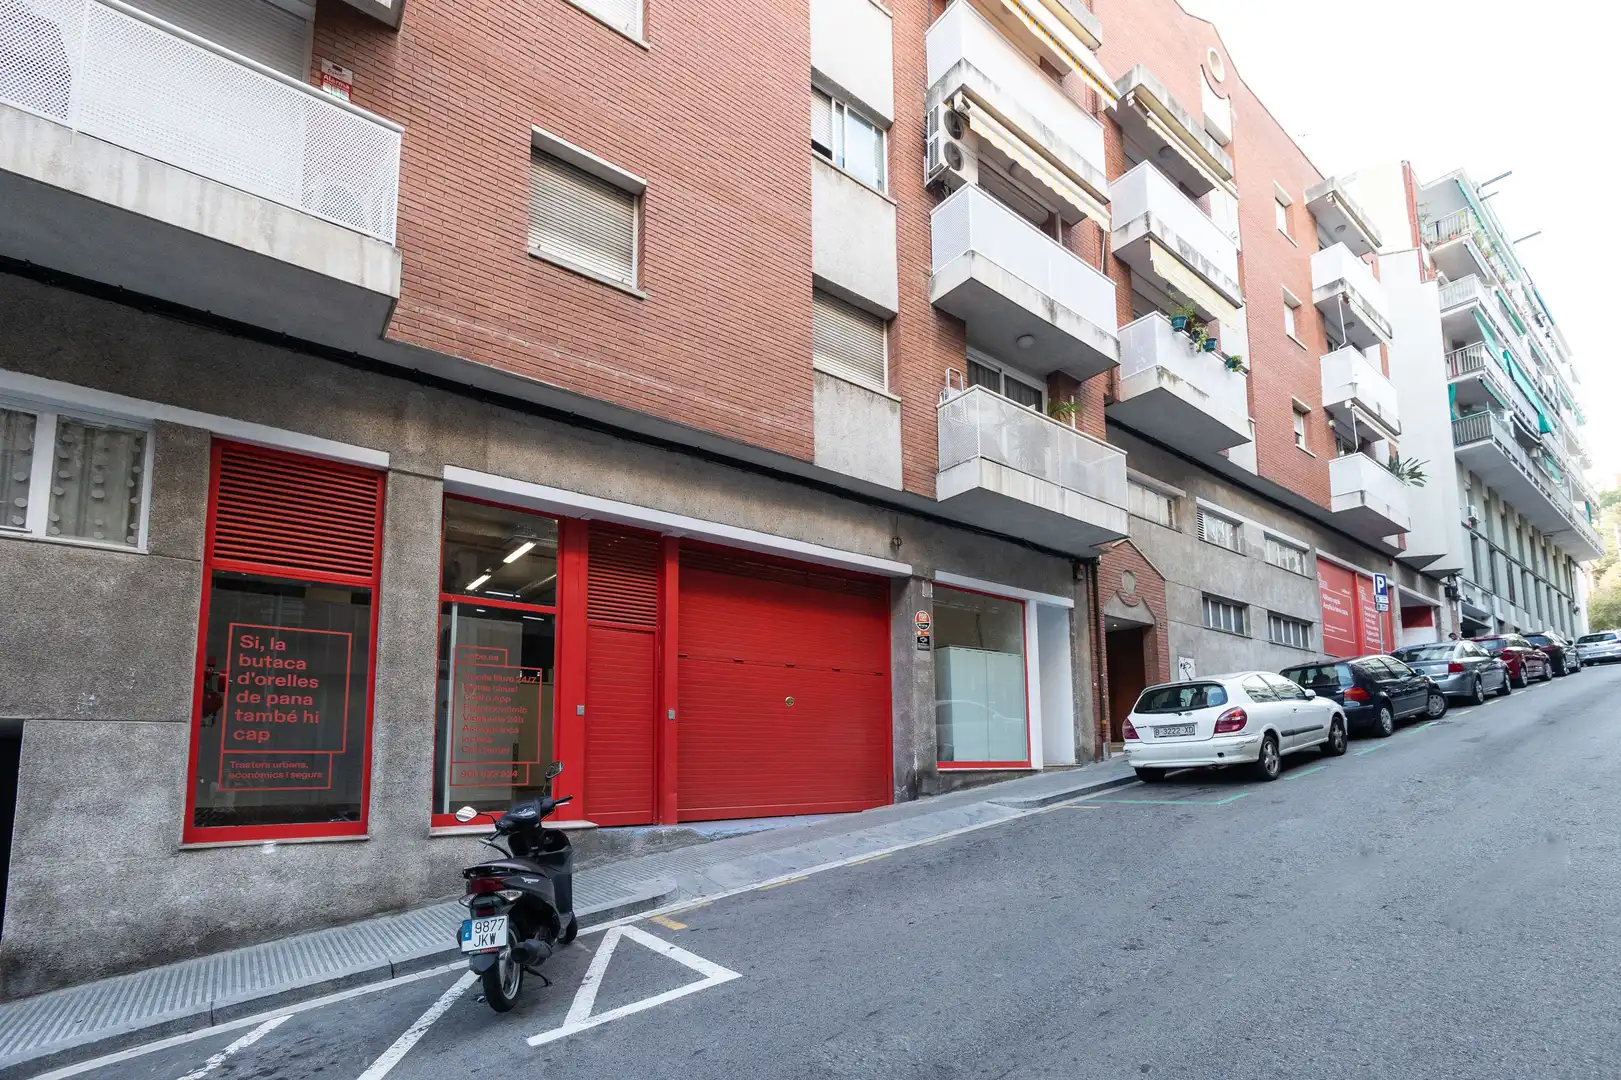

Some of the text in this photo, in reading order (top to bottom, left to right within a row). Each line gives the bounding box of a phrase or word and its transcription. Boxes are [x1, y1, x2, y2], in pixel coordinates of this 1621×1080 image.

[323, 74, 350, 90] Alarma
[1376, 576, 1385, 594] P
[270, 636, 287, 651] la
[239, 653, 307, 670] butaca
[237, 672, 319, 688] d'orelles
[516, 675, 537, 684] 24/7
[236, 690, 313, 708] de pana
[235, 709, 319, 724] també hi
[233, 730, 270, 743] cap
[474, 918, 505, 934] 9877
[474, 932, 497, 947] JKW
